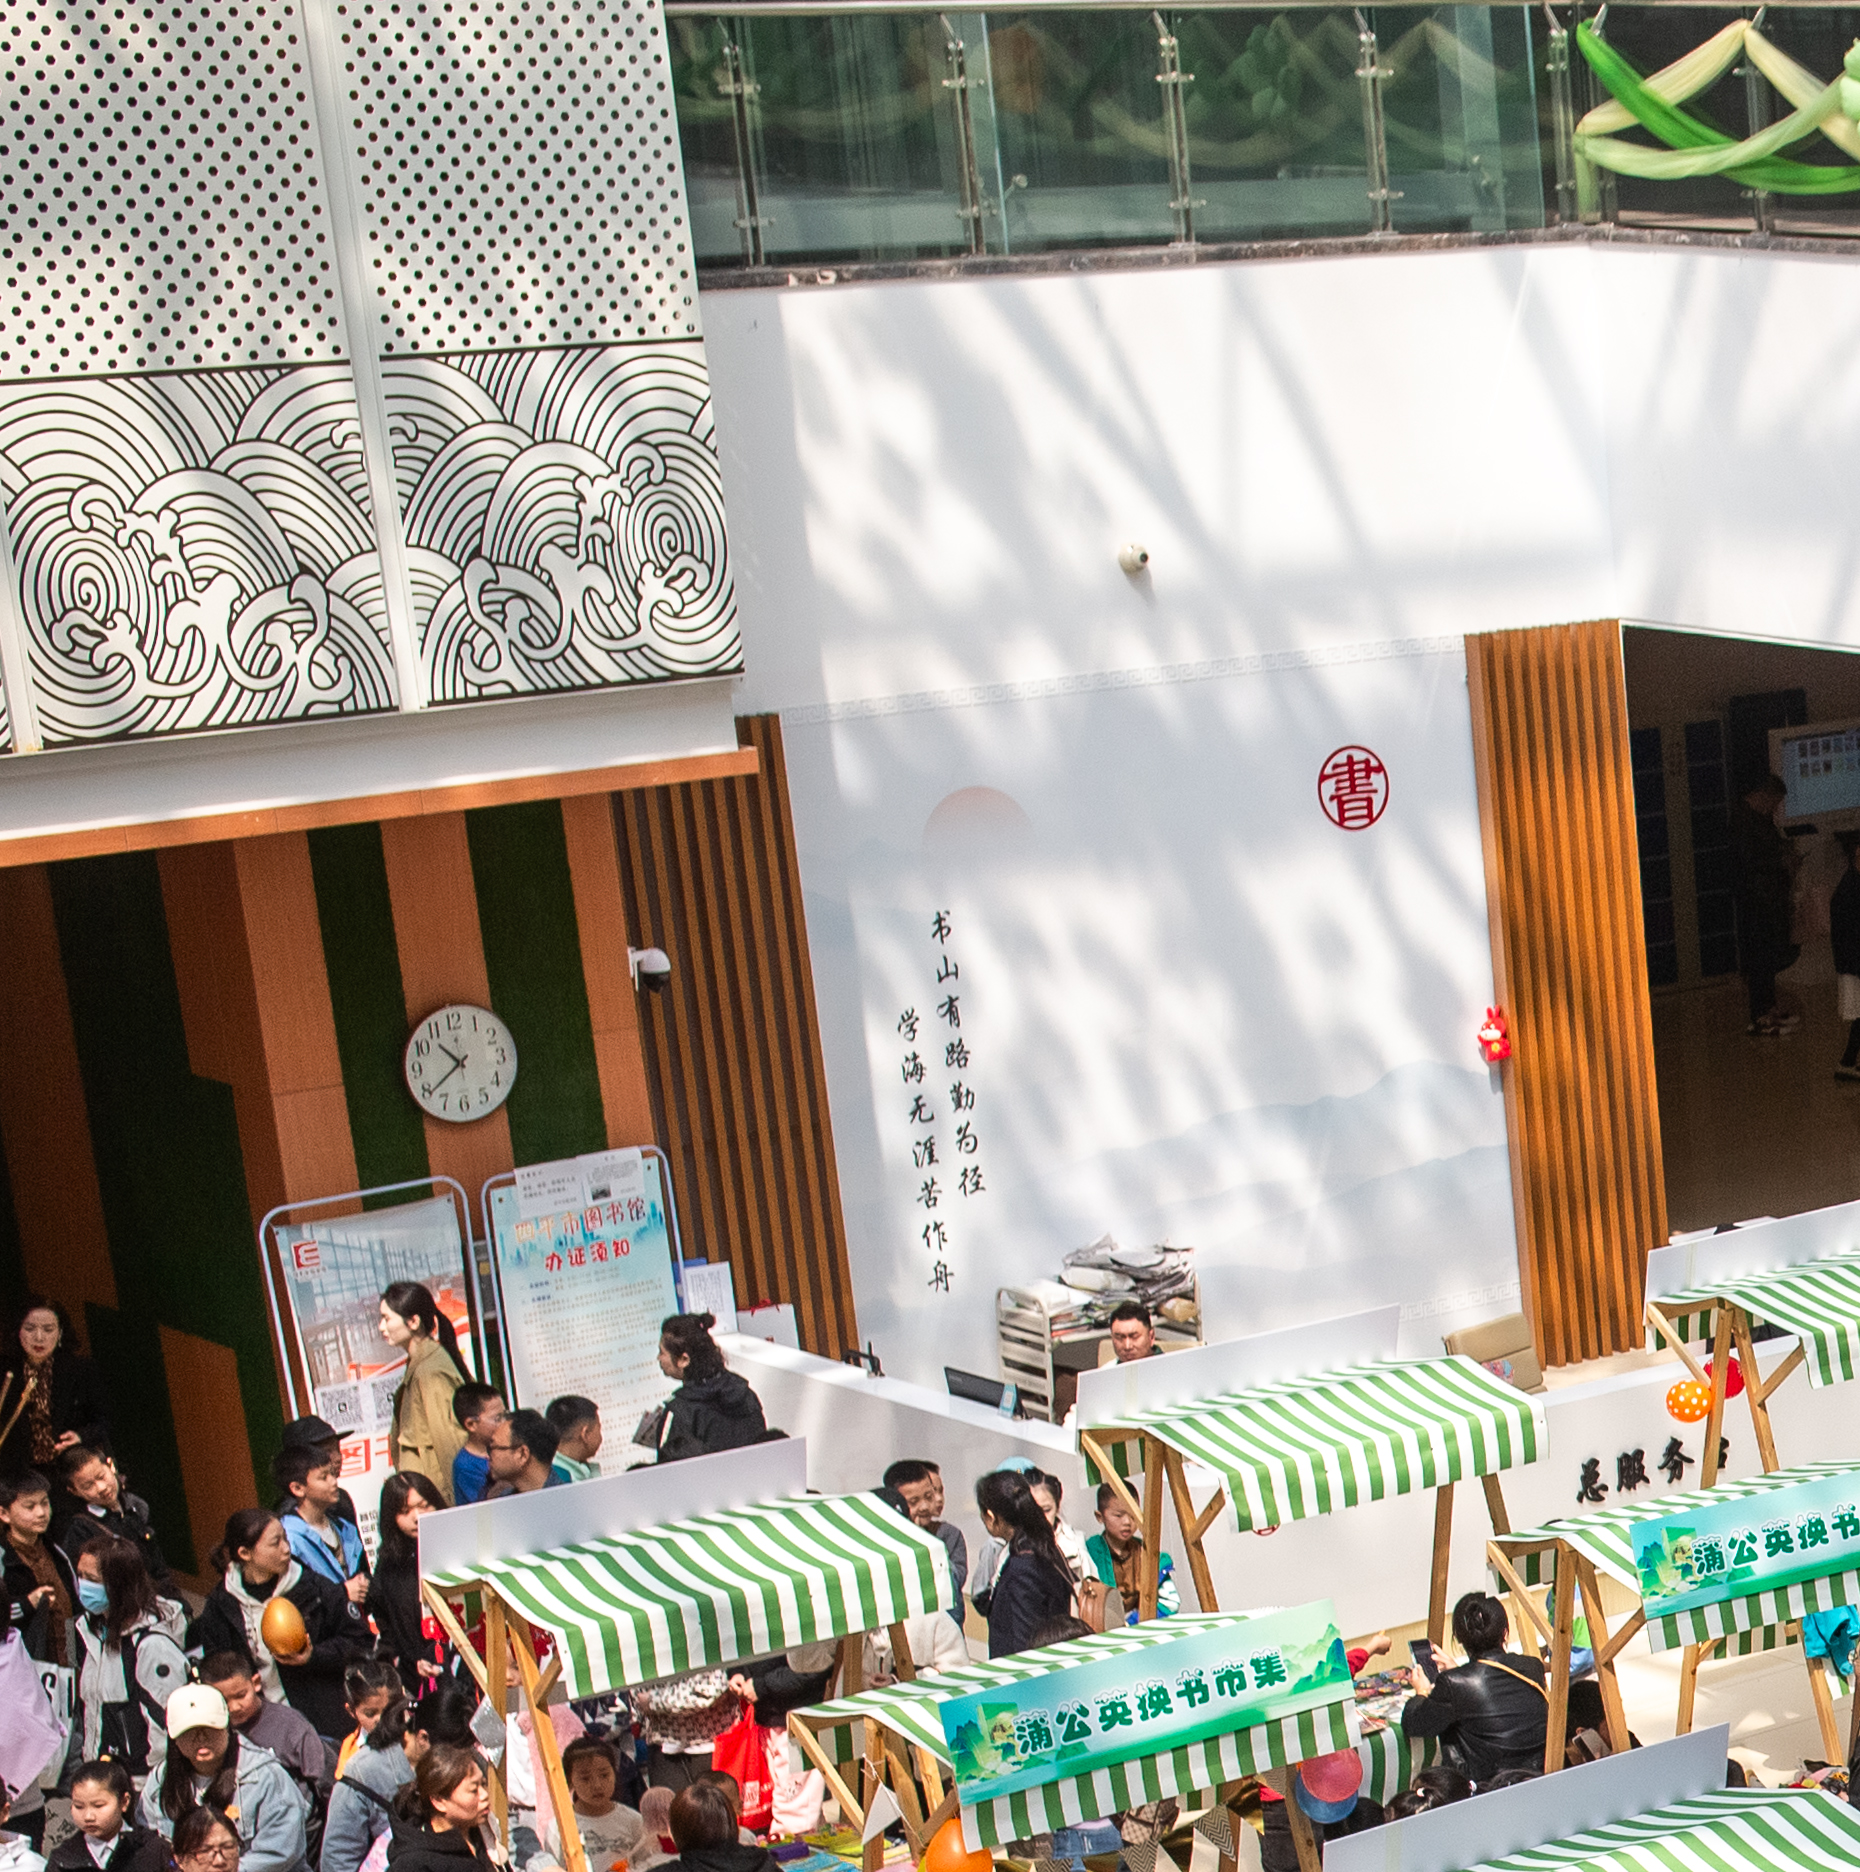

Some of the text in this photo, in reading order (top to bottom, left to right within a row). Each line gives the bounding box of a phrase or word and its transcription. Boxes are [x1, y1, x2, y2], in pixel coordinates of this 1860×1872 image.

[1321, 752, 1386, 826] 書
[931, 909, 987, 1197] 书山有路勤为径
[897, 1007, 955, 1293] 学海无涯苦作舟
[514, 1196, 647, 1243] 四平市图书馆
[545, 1238, 631, 1272] 办证须知
[1013, 1646, 1288, 1755] 蒲公英换书市集
